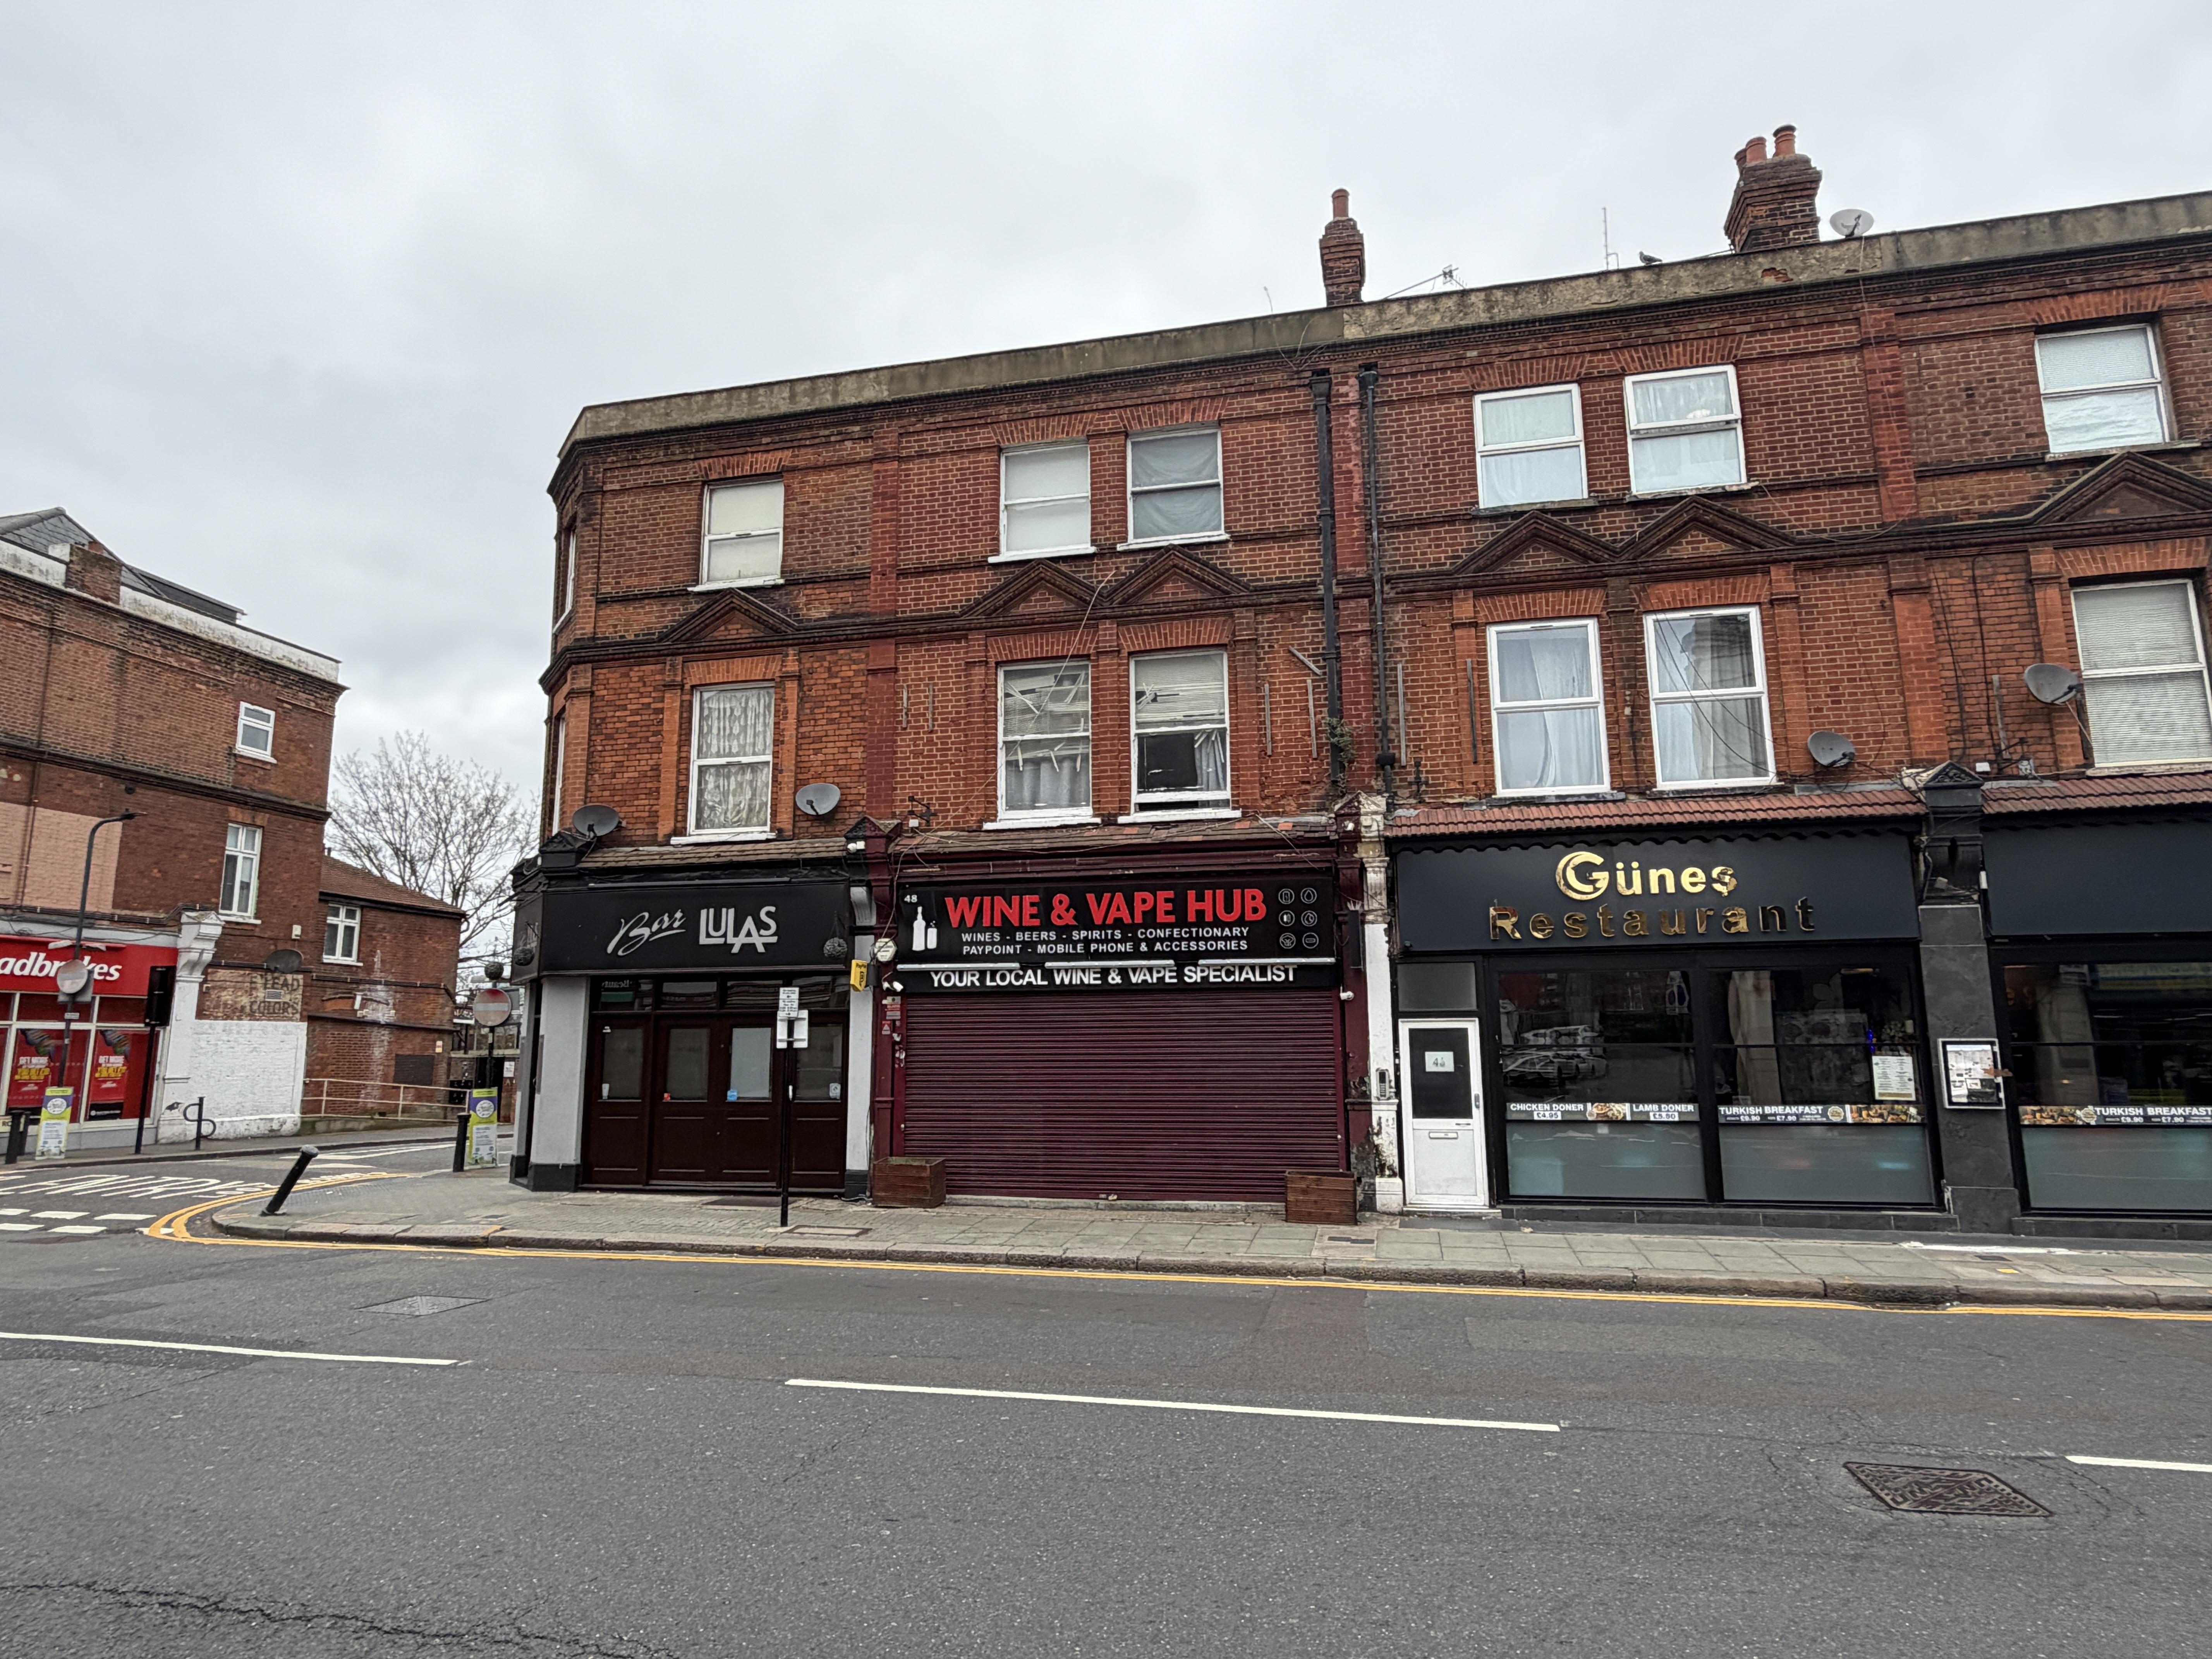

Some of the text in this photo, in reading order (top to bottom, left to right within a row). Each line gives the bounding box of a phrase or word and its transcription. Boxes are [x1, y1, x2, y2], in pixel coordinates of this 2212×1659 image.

[904, 894, 917, 903] 48
[945, 888, 1267, 928] WINE & VAPE HUB
[1489, 896, 1815, 940] Restaurant
[607, 906, 778, 956] Bar LULAS
[961, 932, 1001, 942] WINES
[1015, 931, 1056, 941] BEERS
[1072, 930, 1121, 940] SPIRITS
[1138, 927, 1249, 938] CONFECTIONARY
[963, 945, 1022, 955] PAYPOINT
[1037, 943, 1085, 954] MOBILE
[1090, 942, 1133, 953] PHONE
[1139, 942, 1148, 952] &
[1154, 940, 1248, 951] ACCESSORIES
[0, 951, 122, 981] adbres
[930, 965, 1297, 987] YOUR LOCAL WINE & VAPE SPECIALIST
[1510, 1103, 1584, 1111] CHICKEN DONER
[1633, 1104, 1694, 1112] LAMB DONER
[1718, 1106, 1824, 1115] TURKISH BREAKFAST
[2094, 1107, 2212, 1116] TURKISH BREAKFAST
